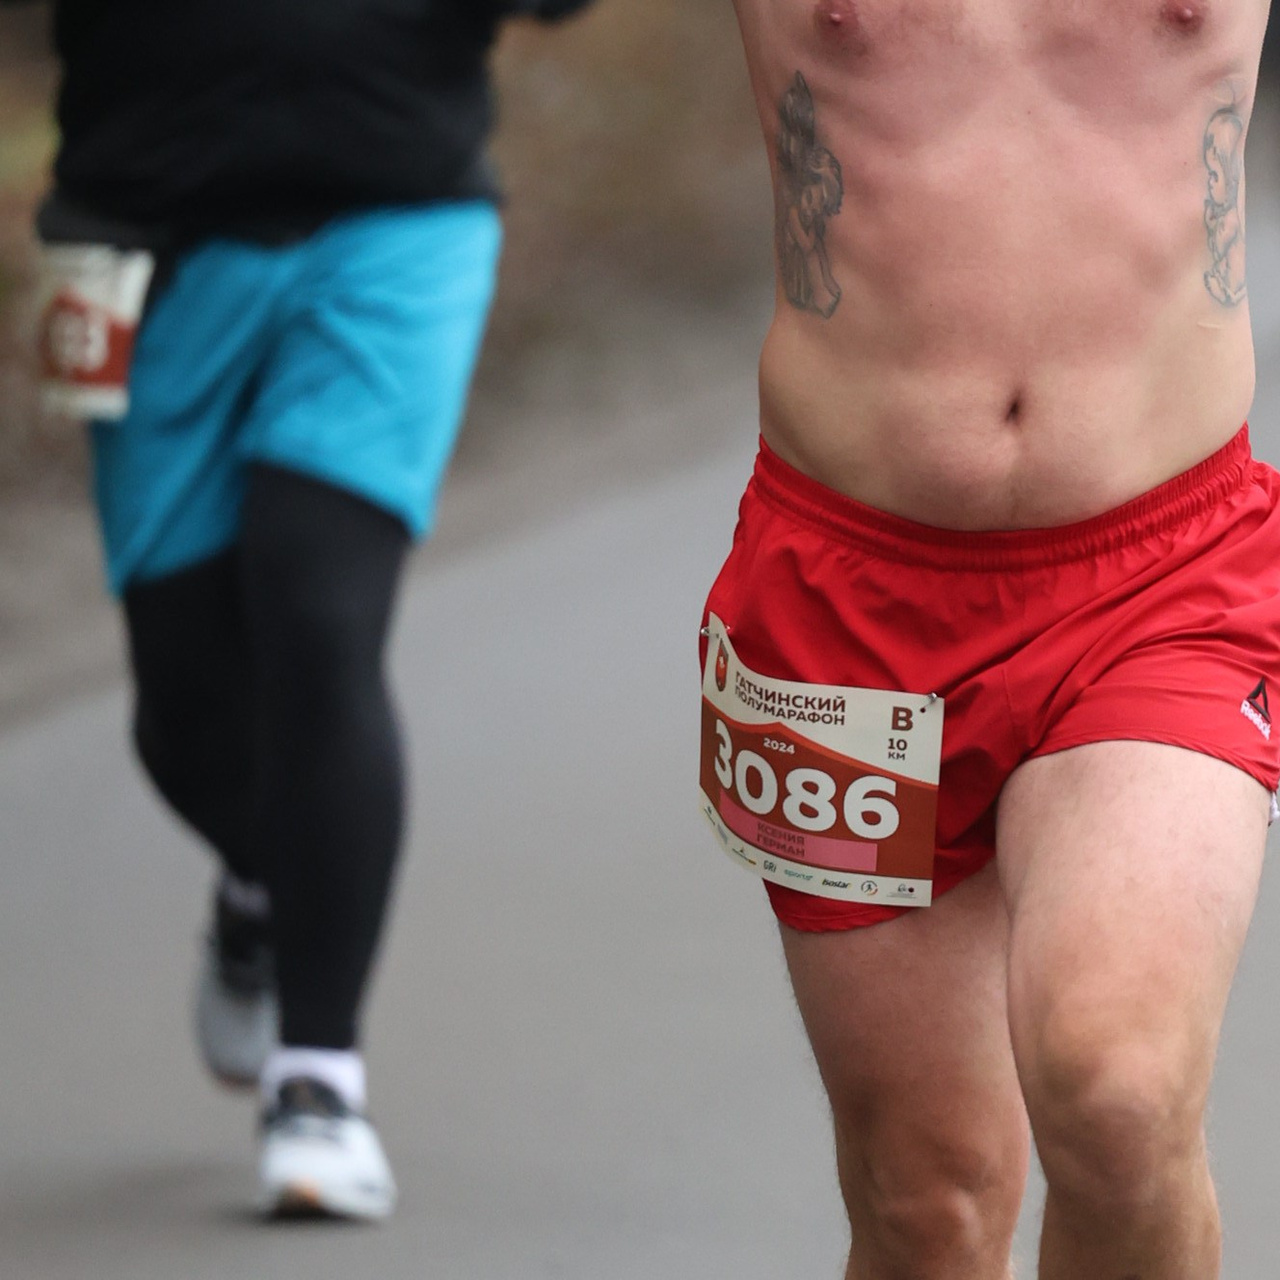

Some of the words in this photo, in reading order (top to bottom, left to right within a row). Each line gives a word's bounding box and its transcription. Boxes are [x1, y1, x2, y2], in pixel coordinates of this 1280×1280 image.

[734, 686, 845, 726] ПОЛУМАРАФОН
[735, 670, 846, 713] ГАТЧИНСКИЙ
[891, 706, 914, 731] В
[1240, 698, 1272, 741] Reebok
[763, 737, 796, 755] 2024
[888, 737, 908, 752] 10
[714, 718, 900, 840] 3086
